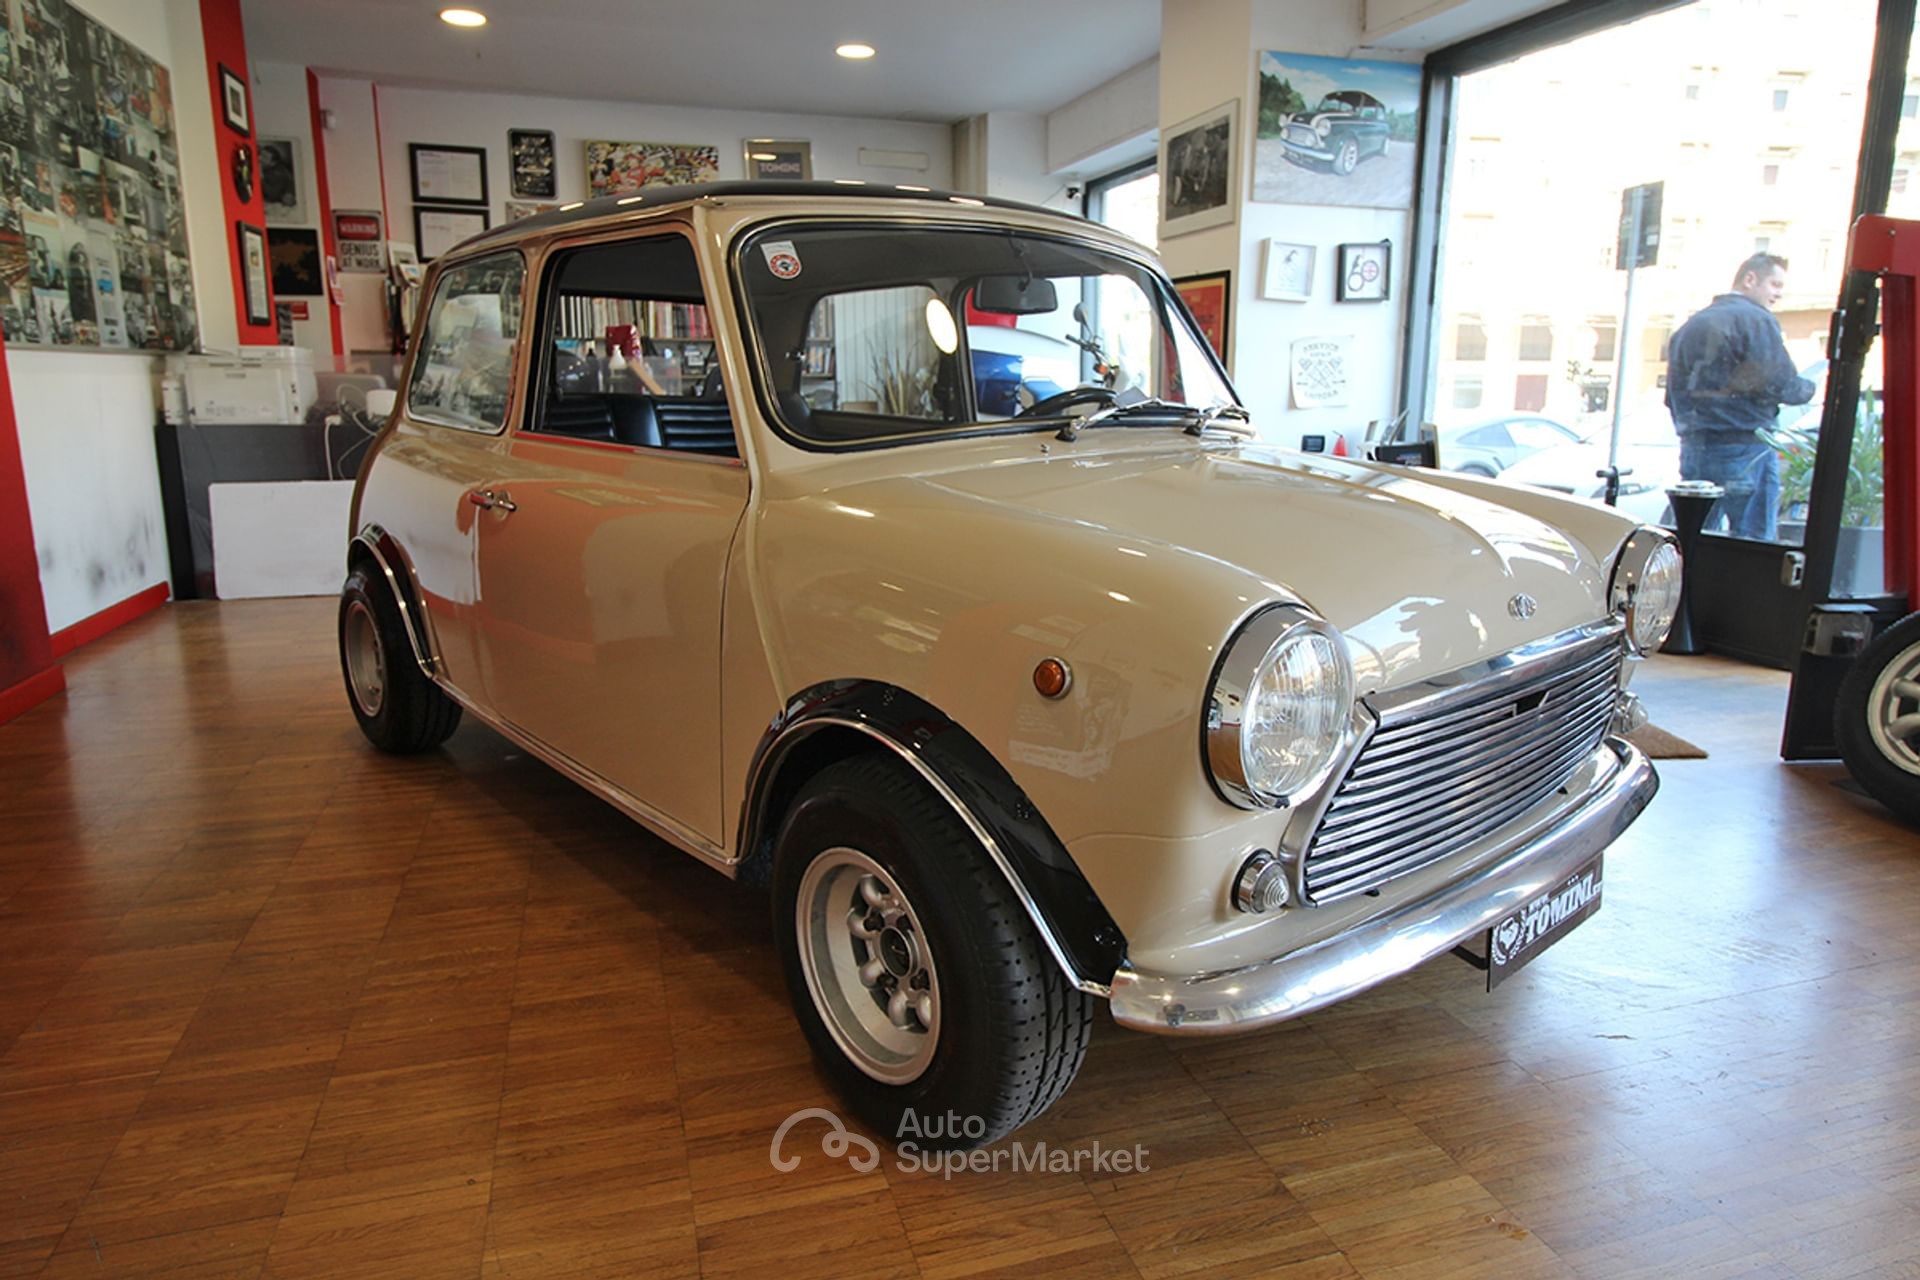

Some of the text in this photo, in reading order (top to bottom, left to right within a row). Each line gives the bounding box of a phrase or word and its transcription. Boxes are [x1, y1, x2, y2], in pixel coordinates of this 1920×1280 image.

[341, 243, 379, 256] GENIUS
[343, 257, 380, 268] AT WORK
[1525, 873, 1593, 943] TOMINI
